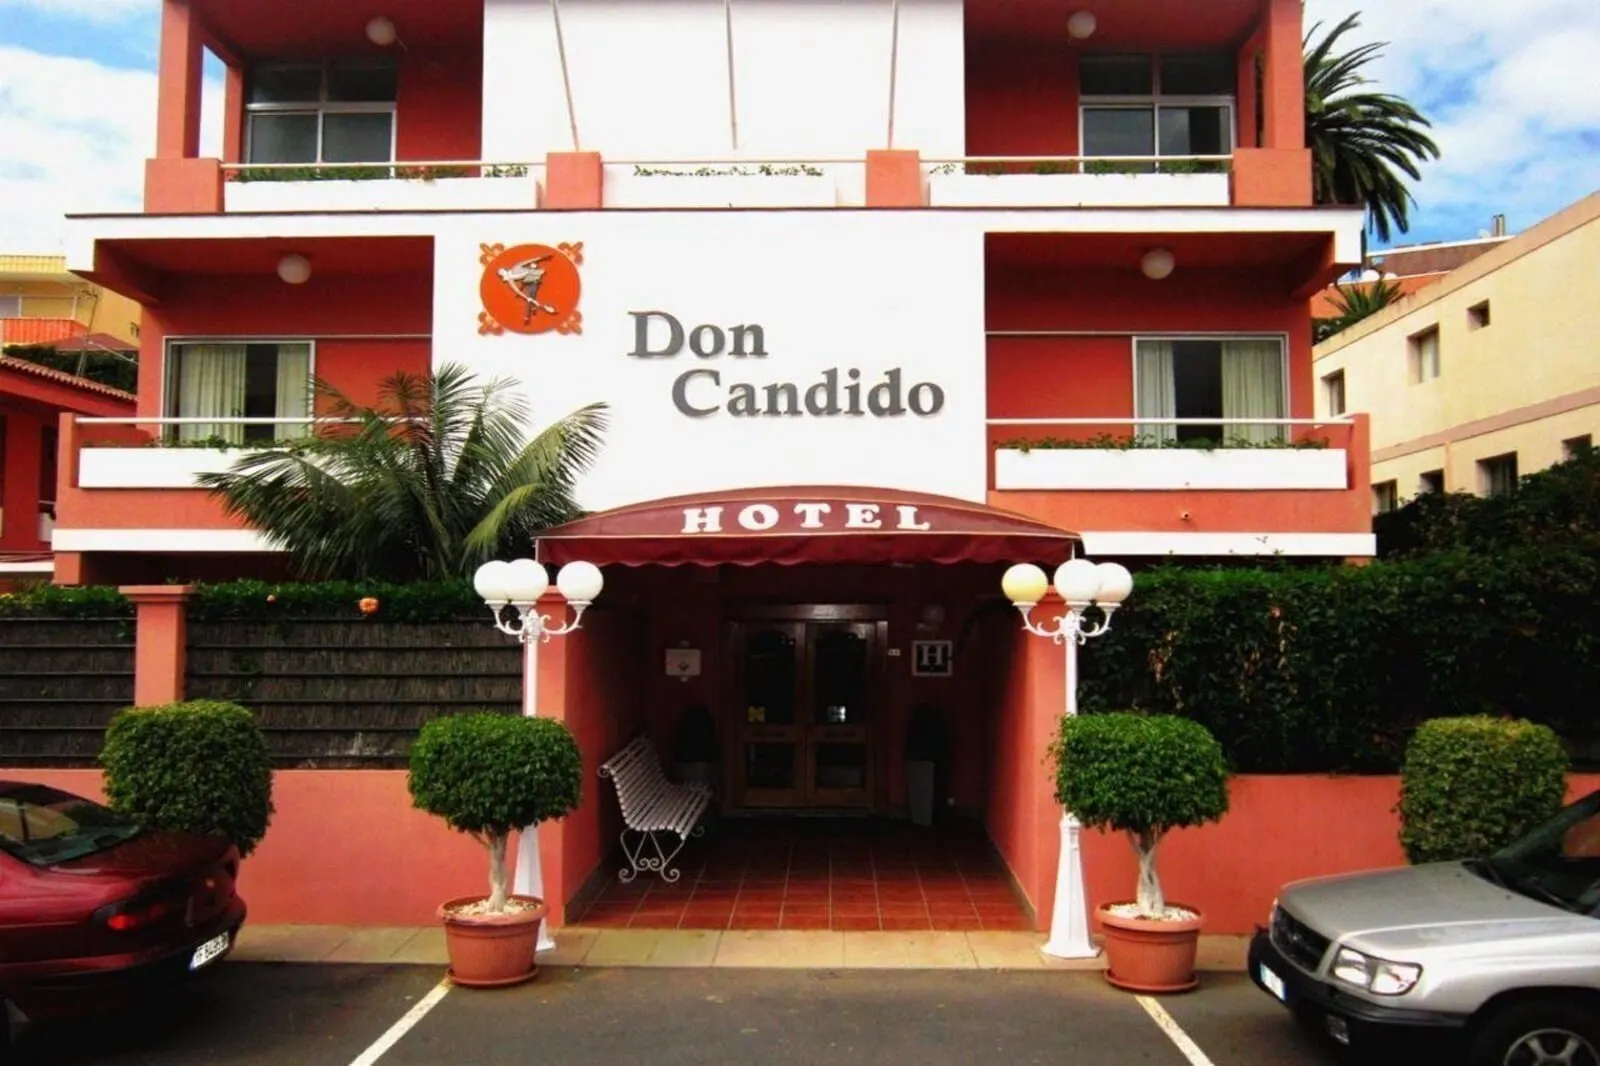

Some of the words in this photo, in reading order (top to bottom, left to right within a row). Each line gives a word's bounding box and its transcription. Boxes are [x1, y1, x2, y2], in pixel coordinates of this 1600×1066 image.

[628, 311, 768, 358] Don
[672, 368, 944, 417] Candido
[681, 503, 931, 533] HOTEL
[920, 645, 945, 666] H
